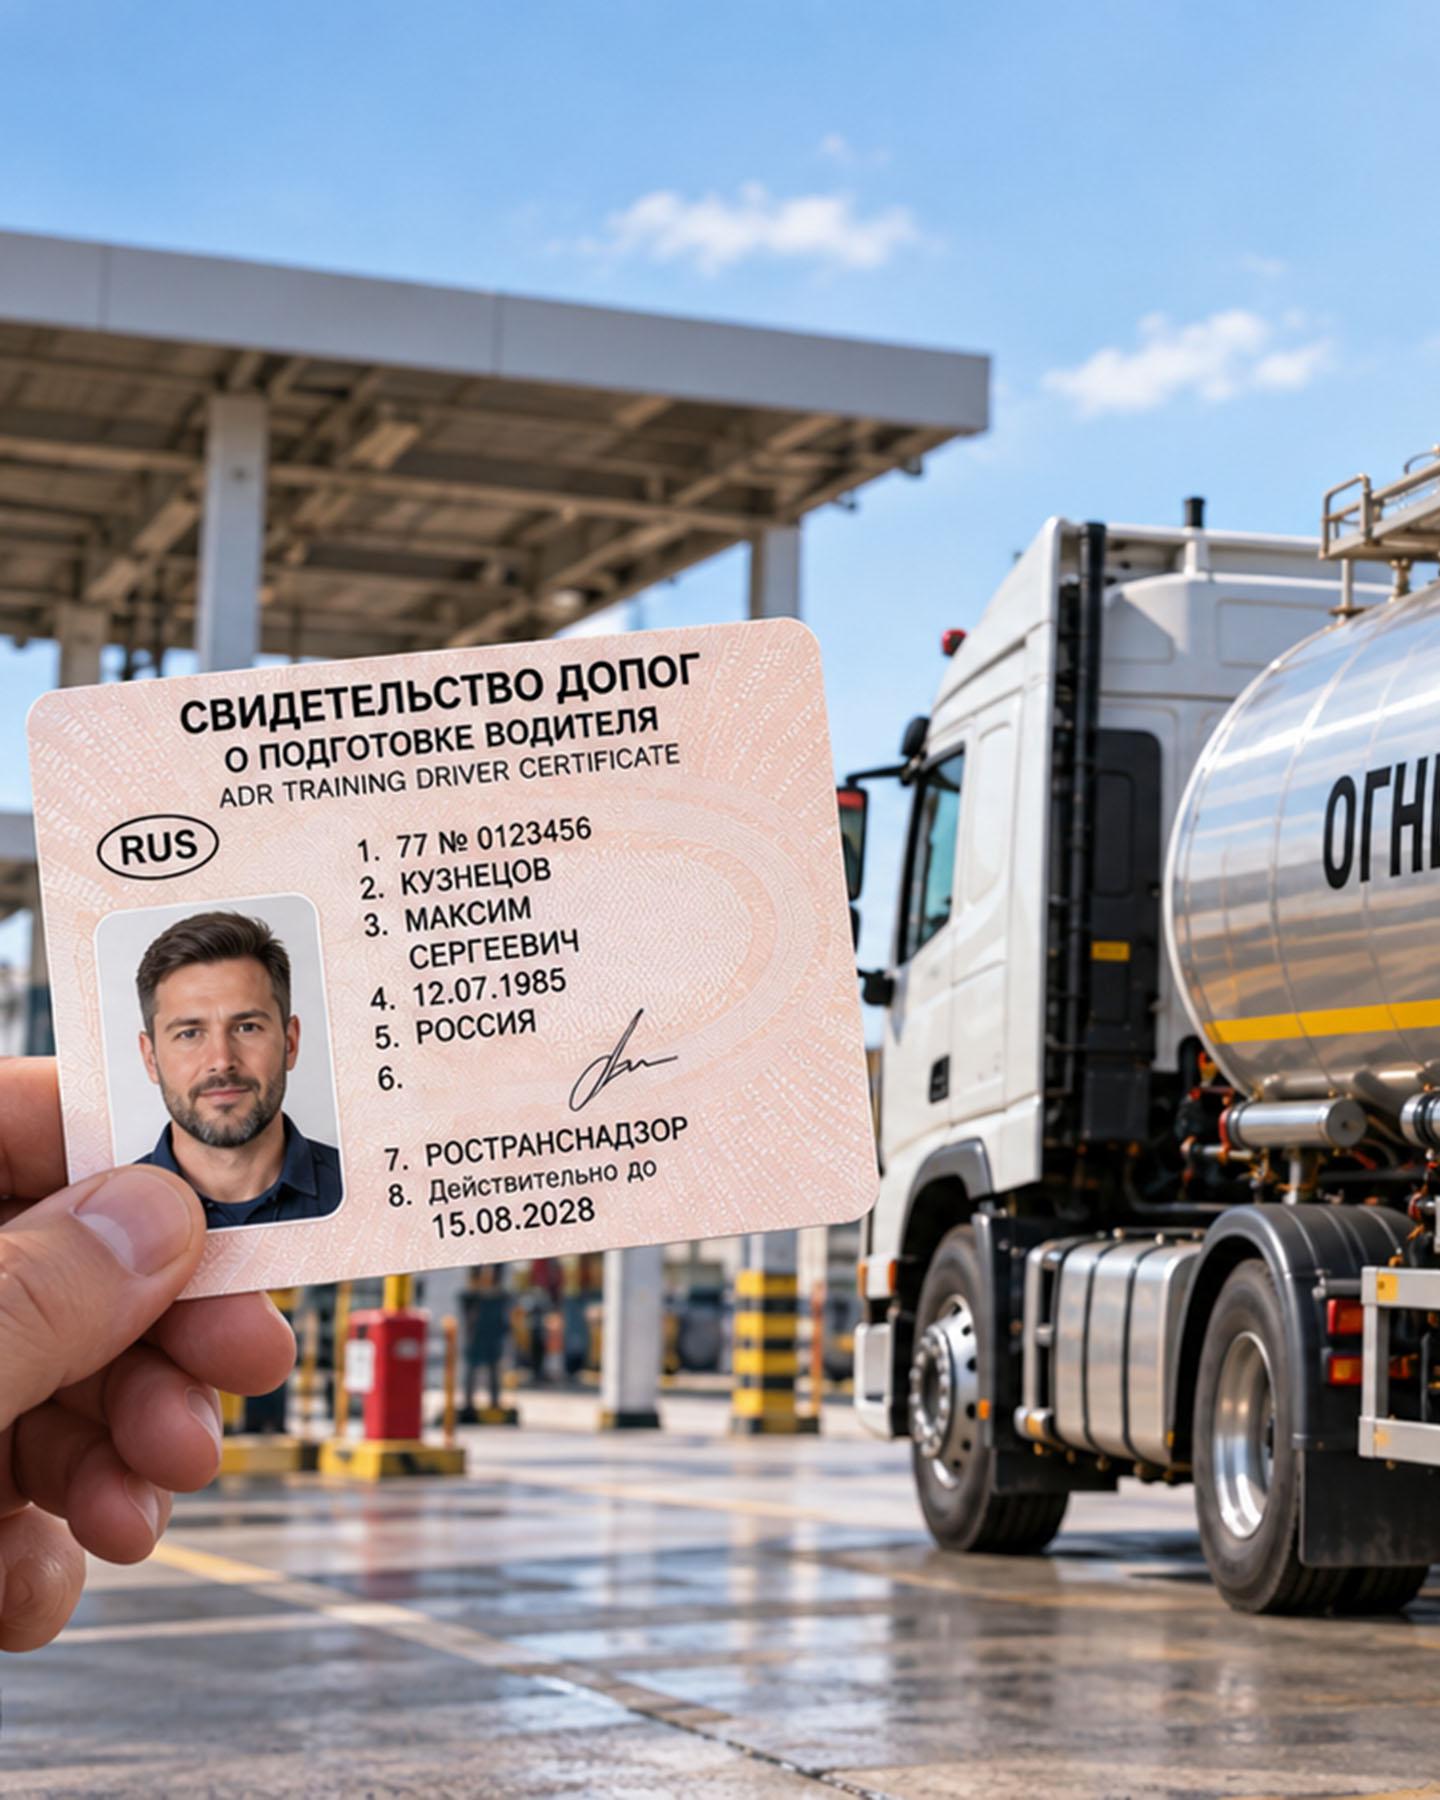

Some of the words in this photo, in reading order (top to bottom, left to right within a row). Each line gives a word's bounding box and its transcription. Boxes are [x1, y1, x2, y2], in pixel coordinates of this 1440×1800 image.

[180, 668, 546, 735] СВИДЕТЕЛЬСТВО
[556, 651, 701, 705] ДОПОГ
[224, 746, 249, 774] О
[259, 724, 475, 771] ПОДГОТОВКЕ
[484, 705, 659, 753] ВОДИТЕЛЯ
[219, 784, 274, 809] ADR
[281, 770, 407, 802] TRAINING
[416, 759, 510, 790] DRIVER
[519, 742, 681, 779] CERTIFICATE
[119, 828, 198, 866] RUS
[357, 839, 380, 863] 1.
[396, 832, 428, 859] 77
[438, 830, 468, 855] №
[477, 815, 592, 851] 0123456
[359, 875, 385, 900] 2.
[400, 857, 552, 896] КУЗНЕЦОВ
[363, 912, 389, 938] 3.
[404, 895, 532, 933] МАКСИМ
[409, 928, 580, 970] СЕРГЕЕВИЧ
[370, 986, 396, 1011] 4.
[413, 967, 567, 1007] 12.07.1985
[375, 1024, 400, 1050] 5.
[415, 1008, 537, 1045] РОССИЯ
[378, 1065, 404, 1092] 6.
[384, 1147, 410, 1172] 7.
[425, 1116, 688, 1167] РОСТРАНСНАДЗОР
[388, 1183, 413, 1208] 8.
[428, 1163, 618, 1206] Действительно
[627, 1159, 657, 1183] до
[432, 1196, 596, 1240] 15.08.2028
